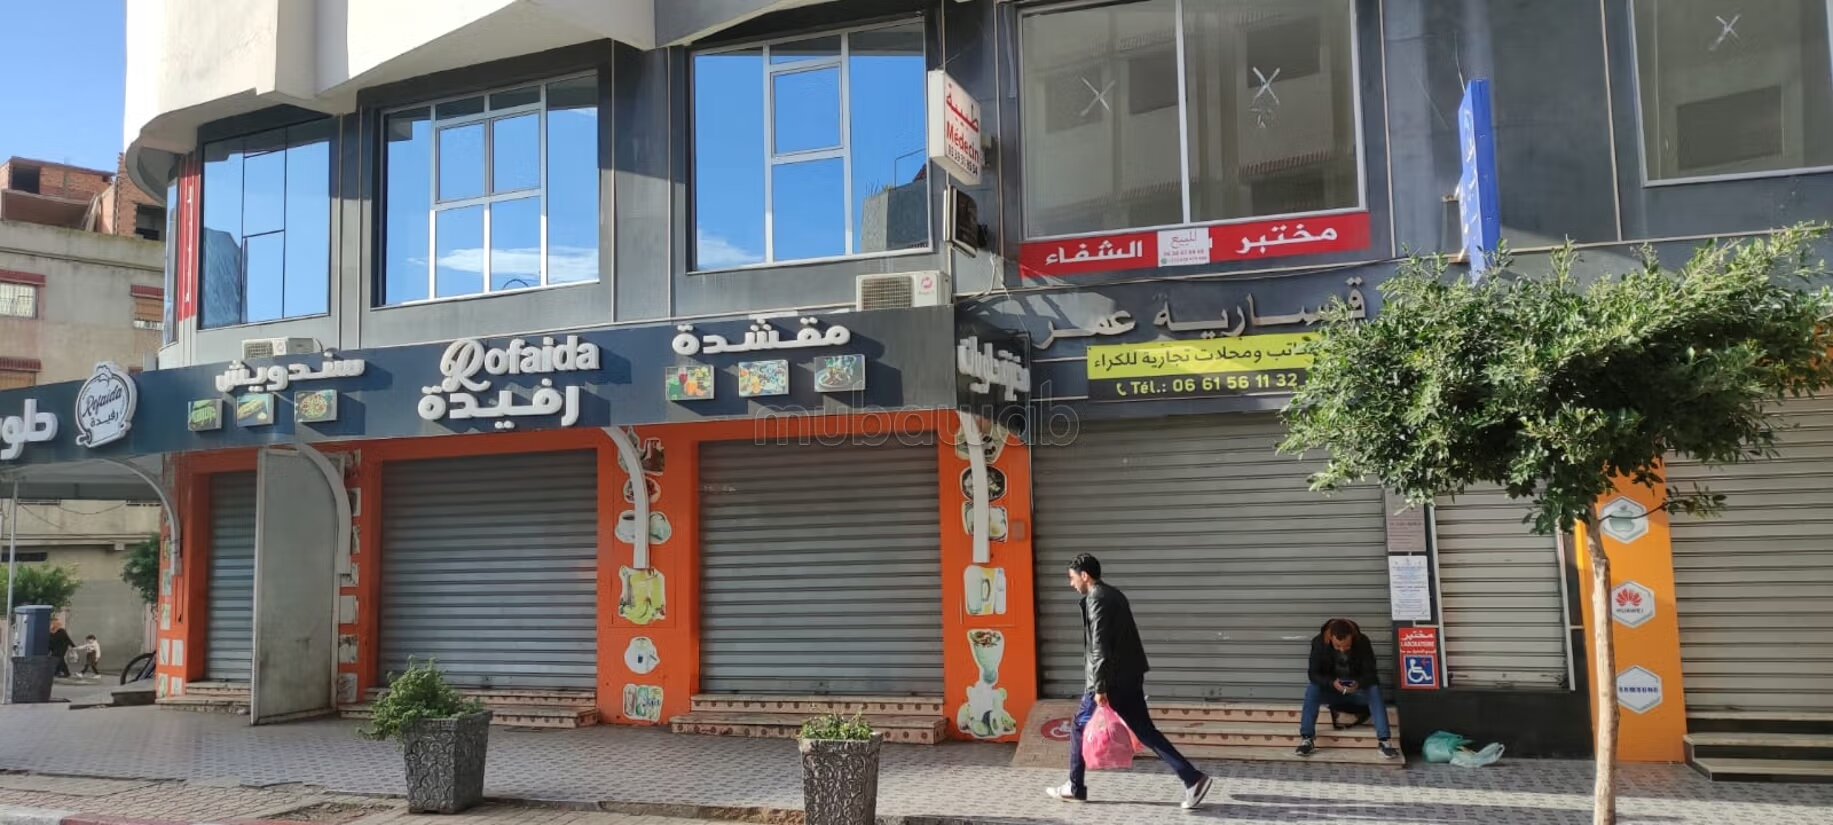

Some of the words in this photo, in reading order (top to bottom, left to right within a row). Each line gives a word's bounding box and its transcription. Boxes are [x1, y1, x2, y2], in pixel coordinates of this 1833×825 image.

[946, 121, 979, 162] Médecin
[1045, 239, 1143, 266] الشفاء
[1235, 223, 1338, 255] مختبر
[671, 316, 851, 356] مقشدة
[1034, 310, 1136, 350] عمر
[215, 349, 366, 393] سندويش
[440, 336, 601, 393] Rofaida
[1094, 353, 1137, 371] للكراء
[1142, 351, 1190, 369] تجارية
[1194, 346, 1262, 364] ومحلات
[1173, 379, 1196, 391] 06
[1202, 377, 1221, 390] 61
[1227, 375, 1249, 388] 56
[1256, 374, 1270, 387] 11
[1276, 373, 1298, 387] 32
[90, 409, 119, 428] رفيدة
[417, 378, 580, 429] رفيدة
[0, 398, 58, 460] طو
